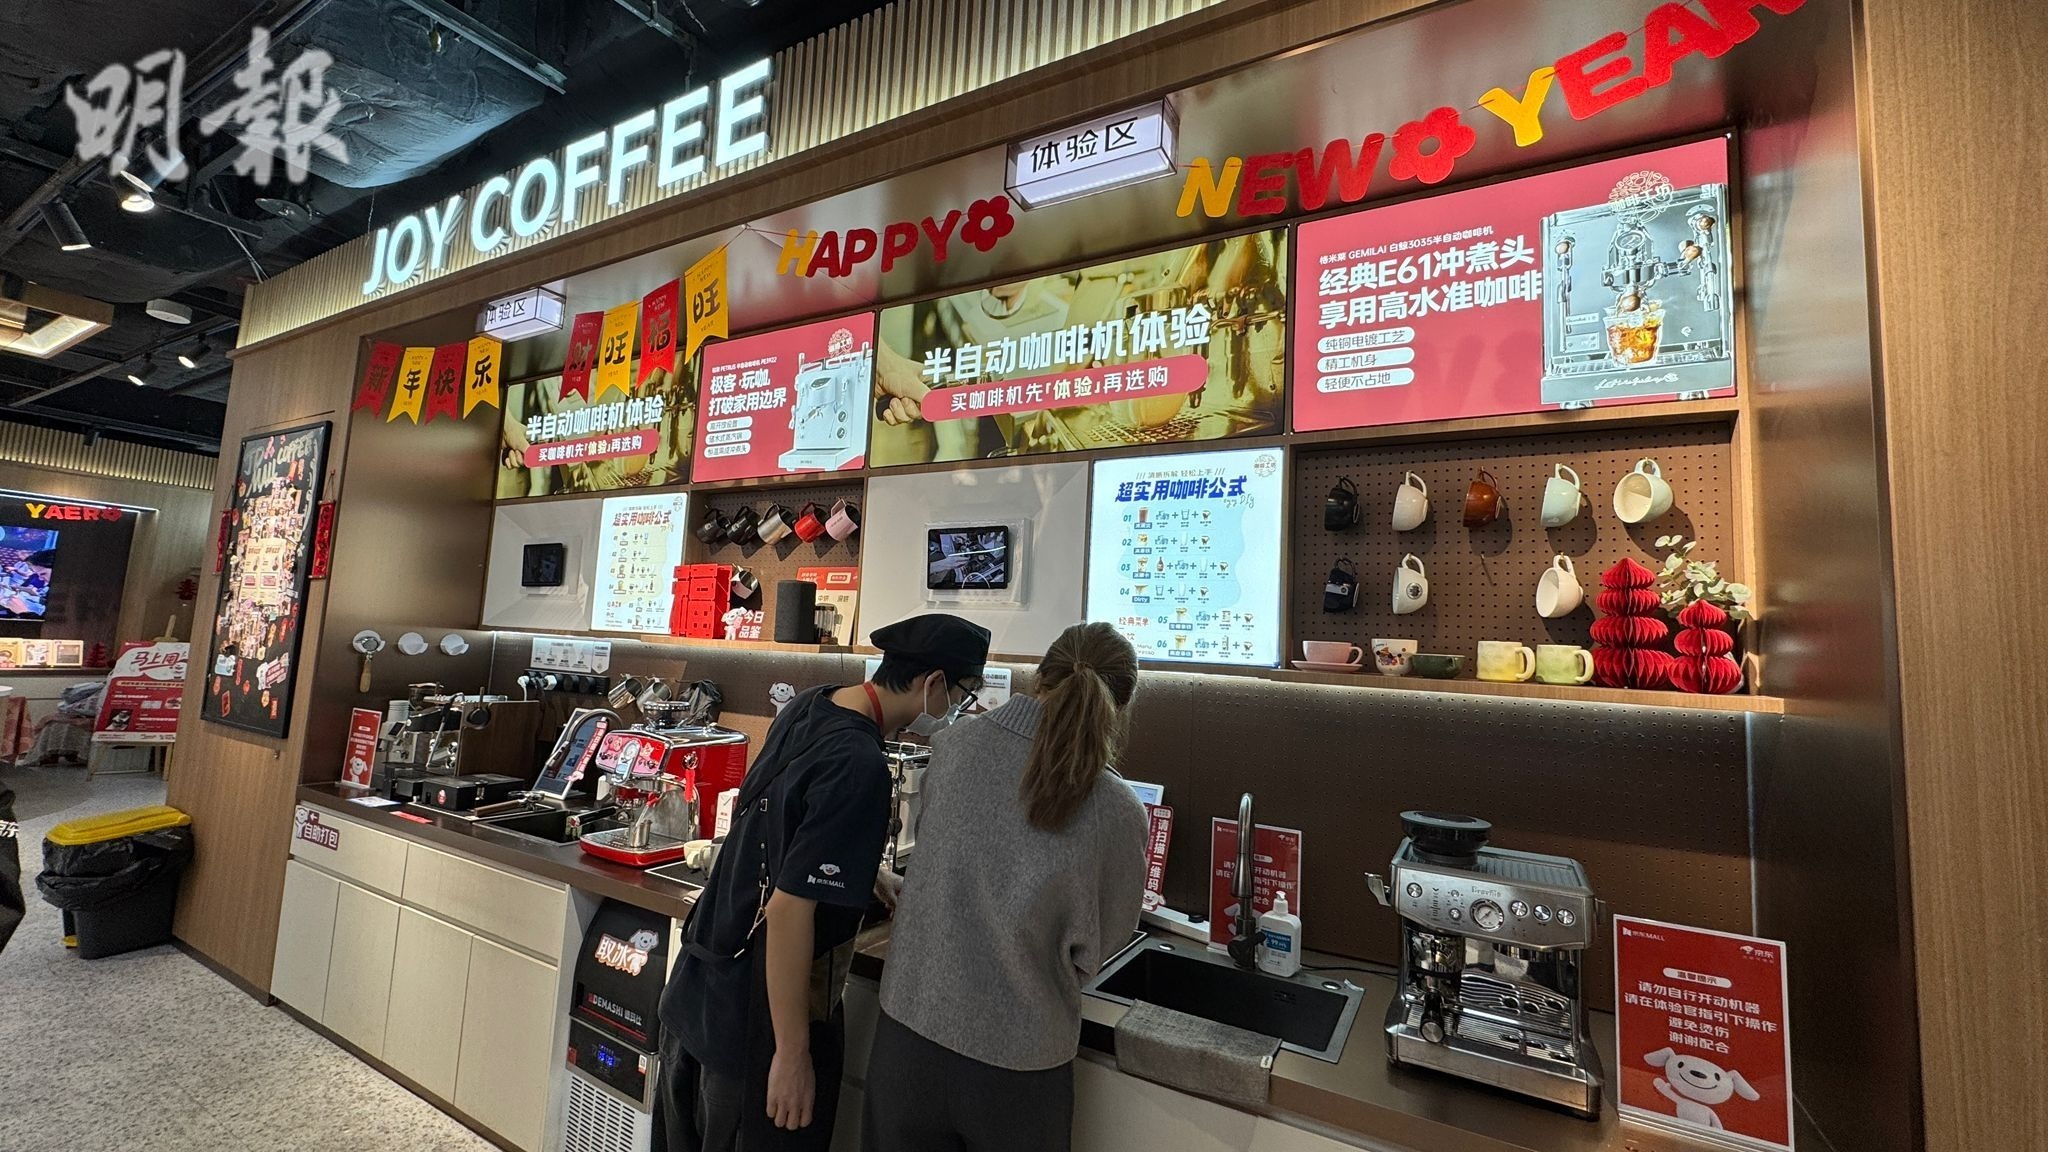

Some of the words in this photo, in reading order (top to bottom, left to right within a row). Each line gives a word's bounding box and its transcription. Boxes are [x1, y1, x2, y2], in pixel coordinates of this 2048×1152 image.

[1030, 116, 1138, 173] 体验区
[362, 194, 464, 294] JOY
[471, 57, 771, 253] COFFEE
[1177, 133, 1384, 217] NEW
[776, 209, 962, 278] HAPPY
[1348, 245, 1387, 260] GEMILAI
[1318, 234, 1535, 297] 经典E61冲煮头
[693, 278, 721, 323] 旺
[1318, 269, 1543, 330] 享用高水准咖啡
[922, 303, 1212, 384] 半自动咖啡机体验
[1325, 330, 1405, 351] 纯铜电镀工艺
[1325, 353, 1377, 371] 精工机身
[1325, 371, 1391, 390] 轻便不占地
[708, 387, 787, 416] 打破家用边界
[526, 395, 664, 441] 半自动咖啡机体验
[1115, 475, 1248, 502] 超实用咖啡公式
[26, 503, 100, 521] YAER
[744, 611, 764, 624] 今日
[1158, 616, 1168, 624] 05
[304, 823, 338, 848] 自助打包
[1638, 980, 1760, 1015] 请勿自行开动机器
[1624, 993, 1777, 1033] 请在体验官指引下操作
[1668, 1016, 1730, 1038] 避免烫伤
[1669, 1031, 1731, 1054] 谢谢配合
